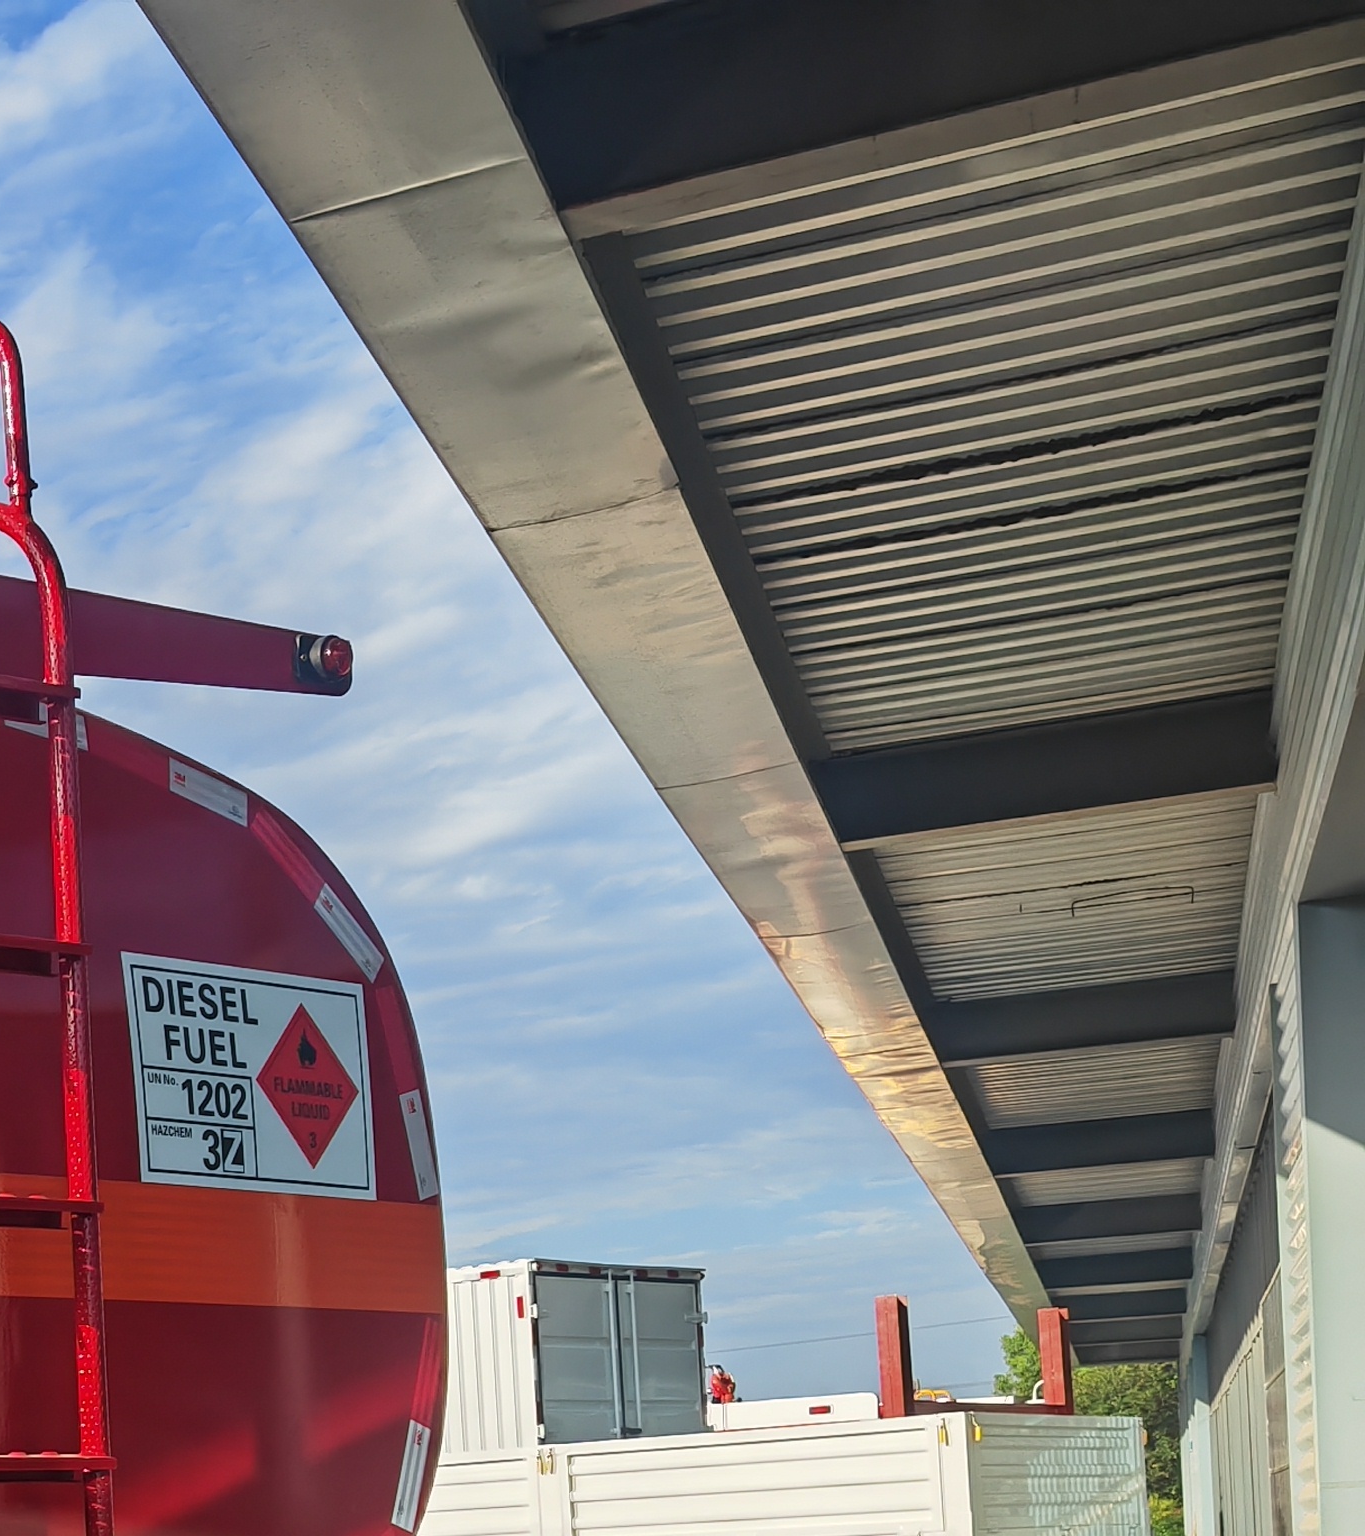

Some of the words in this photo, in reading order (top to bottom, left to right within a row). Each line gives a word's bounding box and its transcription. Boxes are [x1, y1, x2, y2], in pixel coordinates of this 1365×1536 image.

[141, 975, 258, 1025] DIESEL
[163, 1024, 247, 1069] FUEL
[148, 1072, 161, 1084] UN
[163, 1074, 179, 1086] No.
[274, 1076, 343, 1100] FLAMMABLE
[181, 1079, 248, 1120] 1202
[292, 1101, 330, 1120] LIQUID
[151, 1124, 193, 1139] HAZCHEM
[309, 1131, 317, 1149] 3
